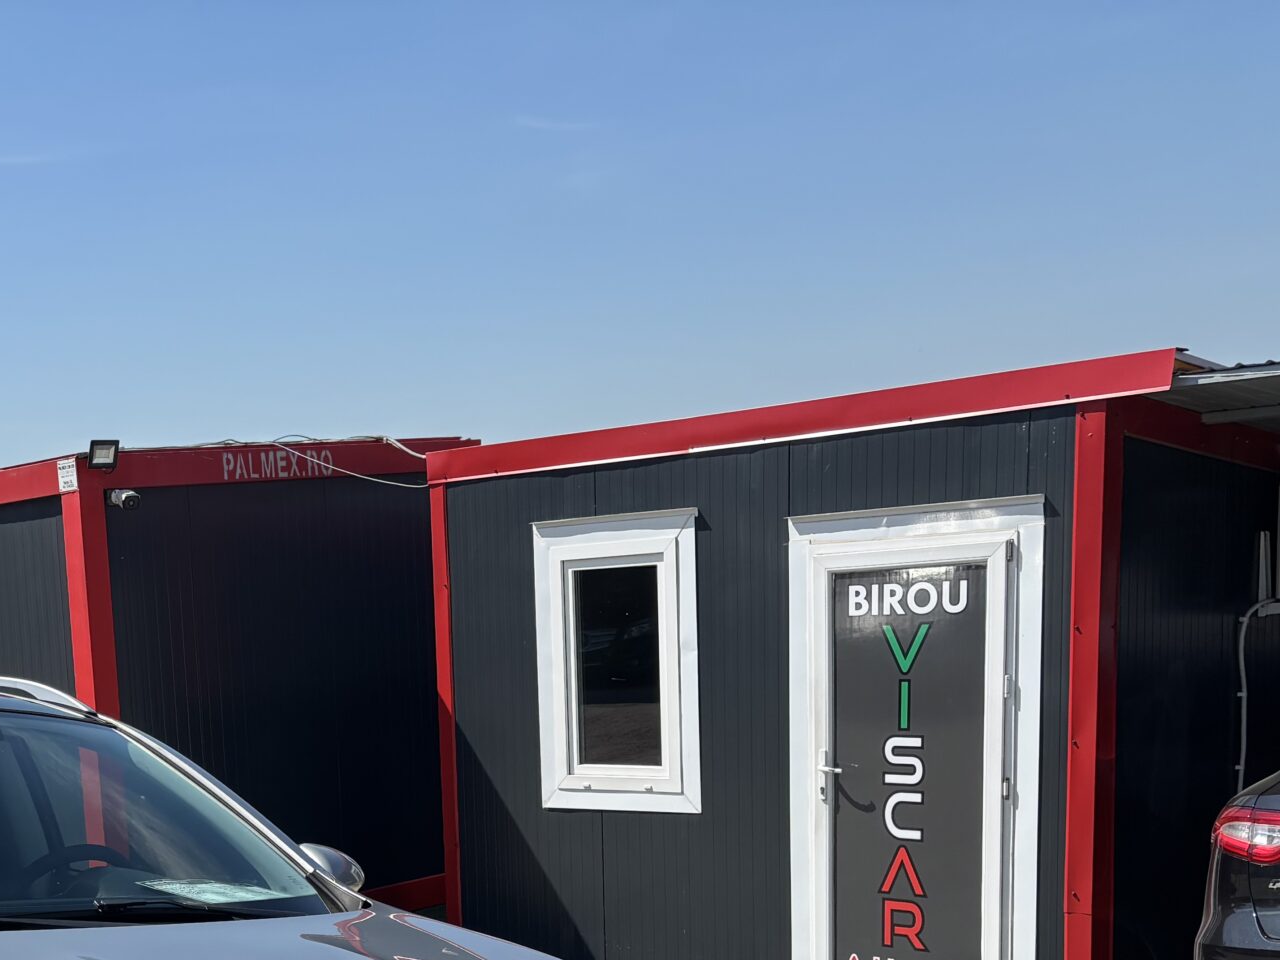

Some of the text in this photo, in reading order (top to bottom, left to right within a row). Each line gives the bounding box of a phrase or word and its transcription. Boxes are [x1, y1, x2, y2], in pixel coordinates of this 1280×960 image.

[223, 450, 332, 480] PALMEX.RO
[848, 580, 968, 617] BIROU
[878, 622, 931, 952] VISCAR
